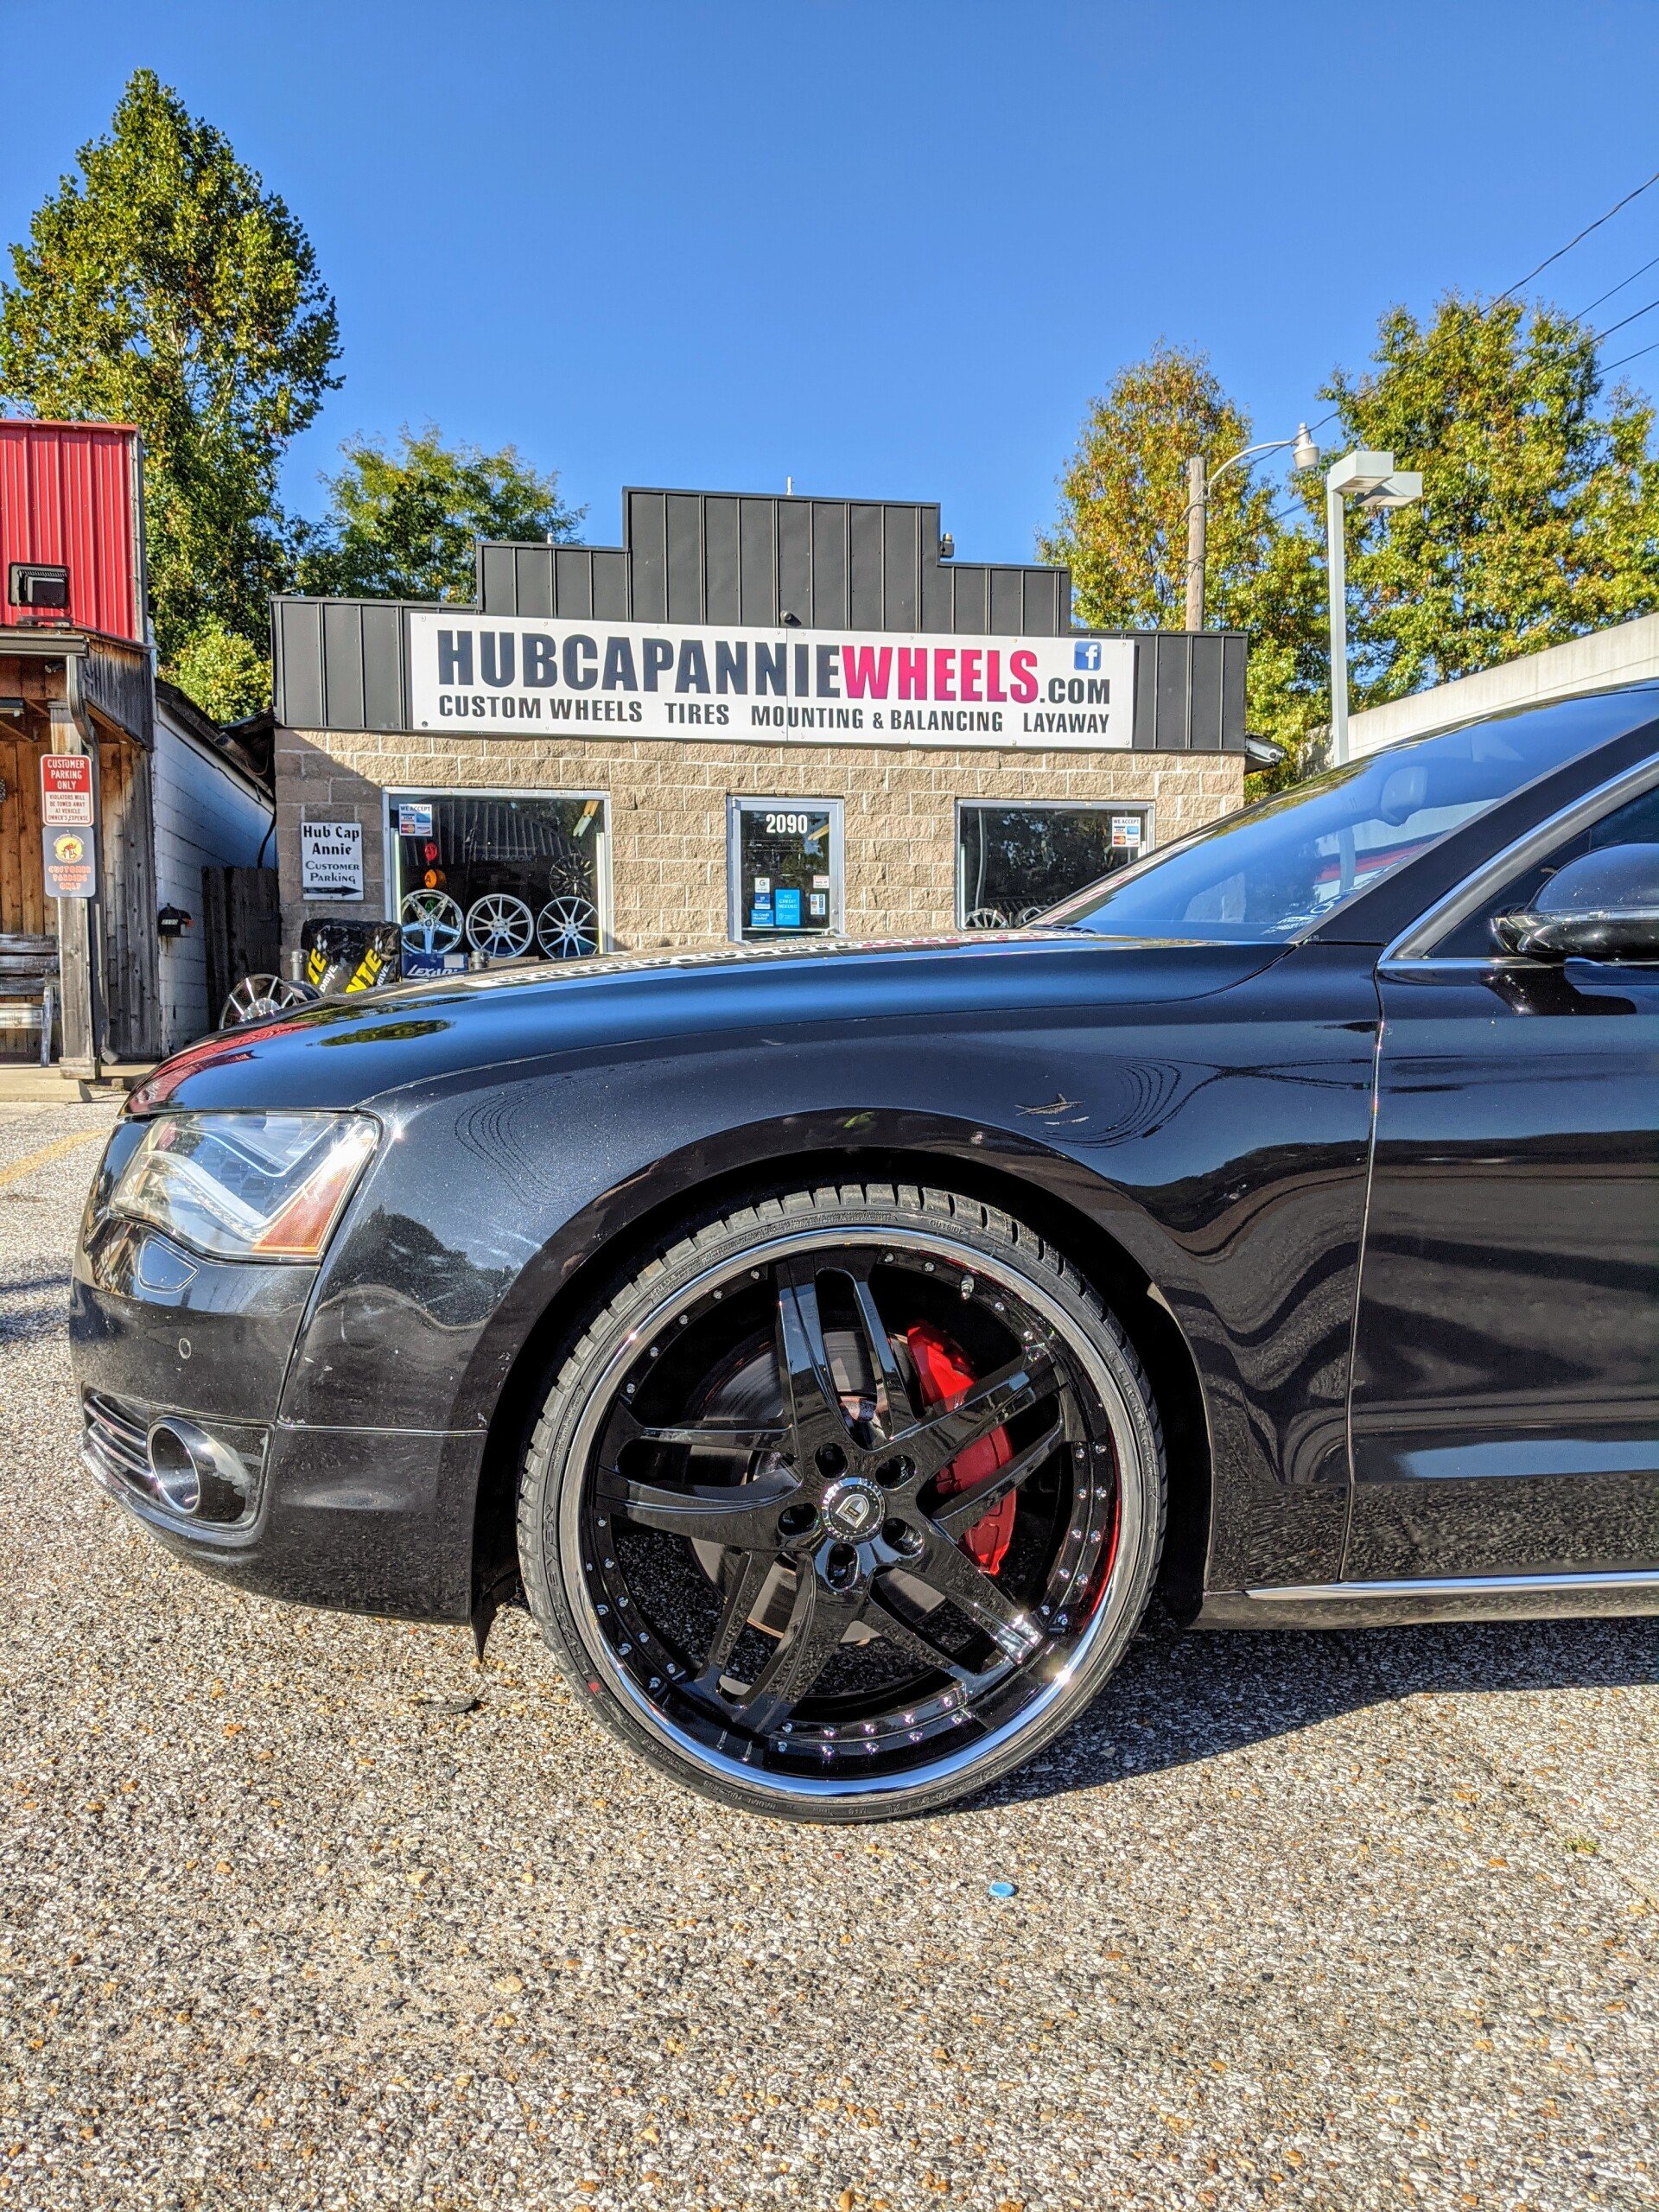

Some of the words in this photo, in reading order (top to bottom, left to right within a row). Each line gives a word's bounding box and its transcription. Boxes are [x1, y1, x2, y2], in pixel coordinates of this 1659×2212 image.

[439, 695, 541, 719] CUSTOM
[550, 698, 642, 722] WHEELS
[664, 702, 729, 725] TIRES
[751, 706, 863, 729] MOUNTING
[873, 712, 884, 729] &
[891, 710, 1002, 732] BALANCING
[1023, 712, 1109, 734] LAYAWAY
[48, 760, 85, 769] CUSTOMER
[51, 770, 82, 779] PARKING
[57, 780, 76, 790] ONLY
[766, 813, 807, 834] 2090
[303, 825, 331, 838] Hub
[335, 825, 359, 842] Cap
[312, 842, 353, 855] Annie
[305, 860, 359, 871] CUSTOMER
